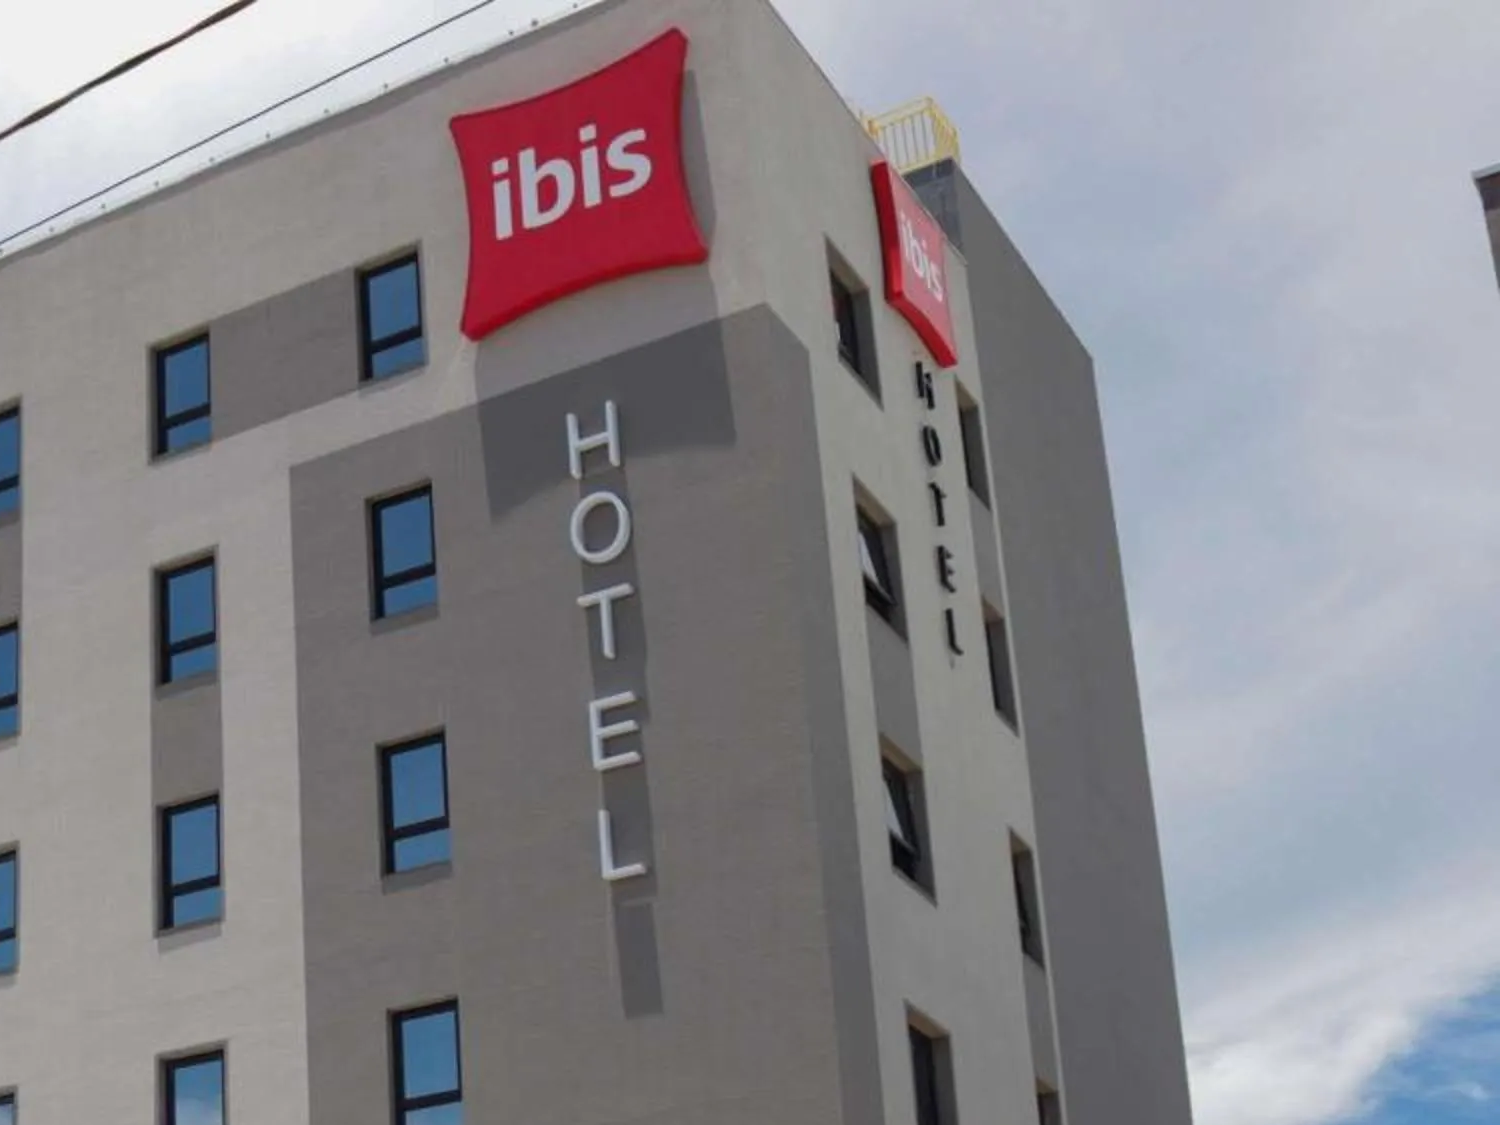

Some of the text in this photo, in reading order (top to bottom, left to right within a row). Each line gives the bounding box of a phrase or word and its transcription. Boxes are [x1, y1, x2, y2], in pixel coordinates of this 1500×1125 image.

[491, 124, 652, 240] ibis
[900, 211, 943, 302] ibis
[915, 361, 964, 656] HOTEL
[566, 400, 647, 880] HOTEL
